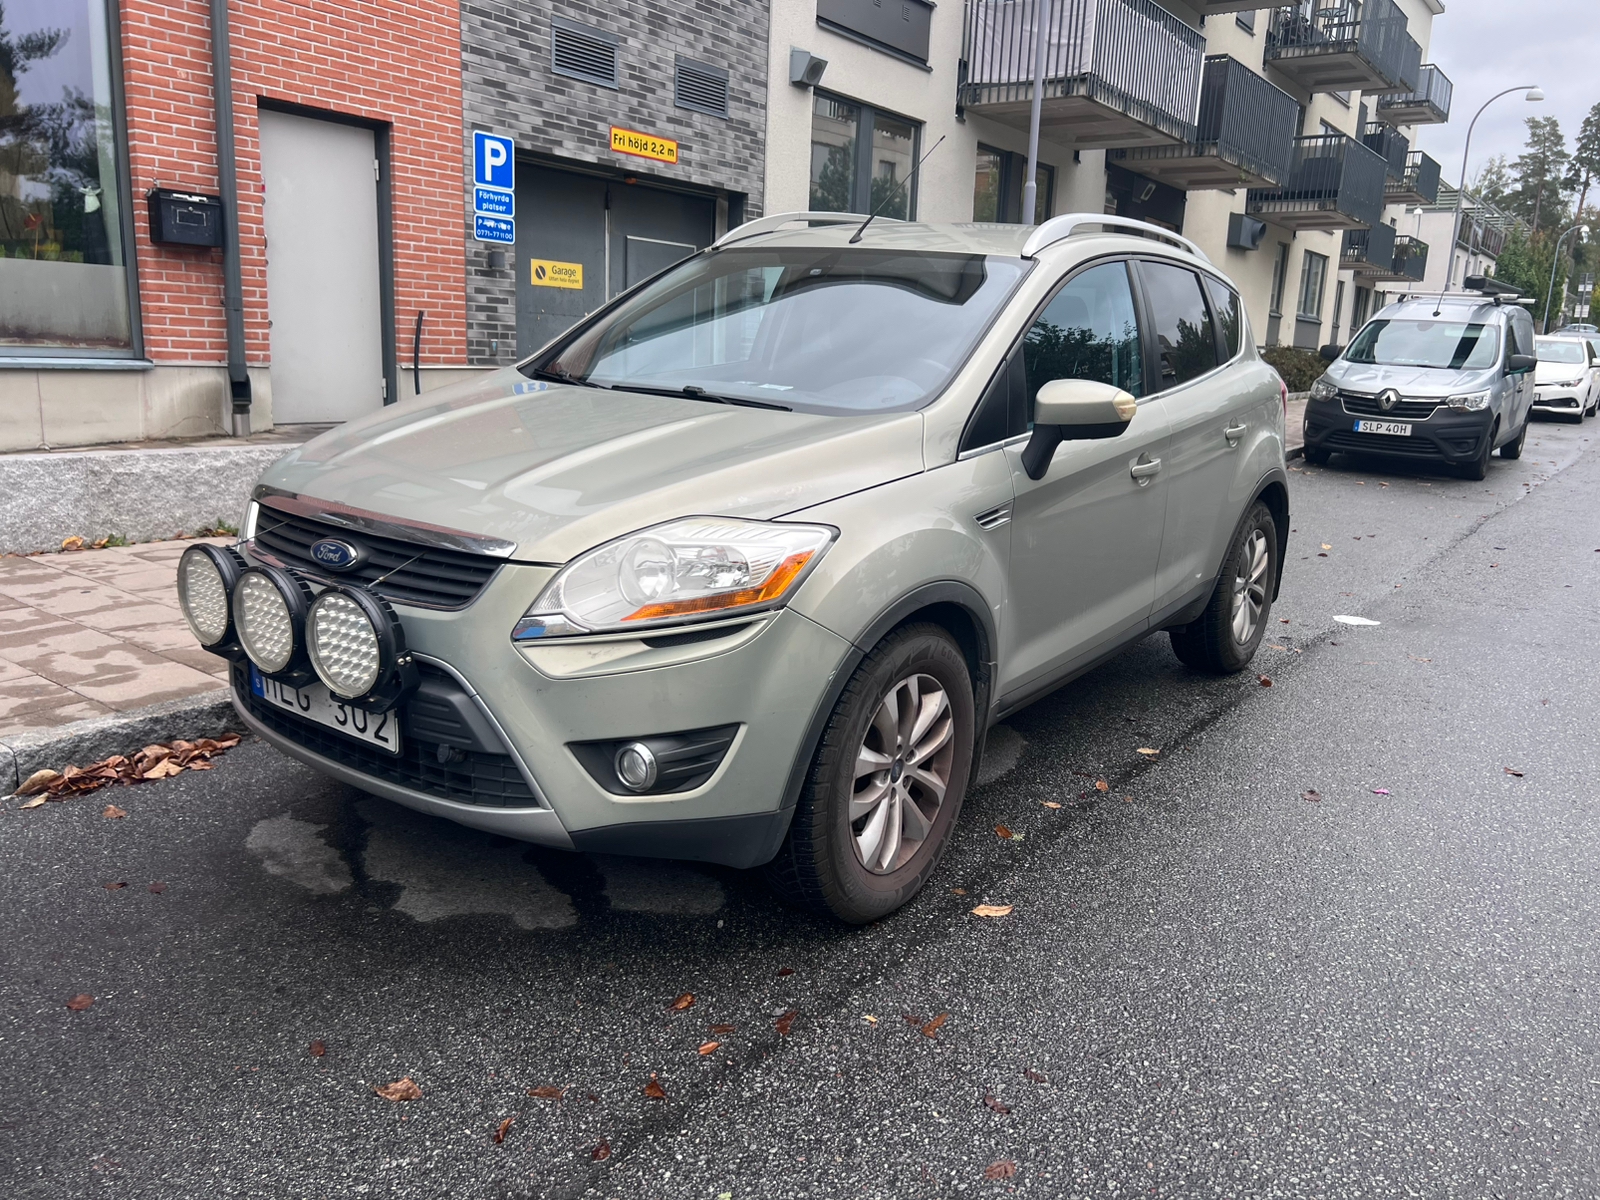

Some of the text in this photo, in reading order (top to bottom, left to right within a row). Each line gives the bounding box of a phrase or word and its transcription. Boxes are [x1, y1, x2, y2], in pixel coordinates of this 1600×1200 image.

[613, 133, 675, 157] Fri höjd 2,2 m
[484, 138, 507, 182] P
[478, 190, 510, 203] Förhyrda
[482, 202, 507, 212] platser
[551, 264, 577, 278] Garage
[1362, 422, 1407, 434] SLP 40H
[317, 543, 342, 562] Ford
